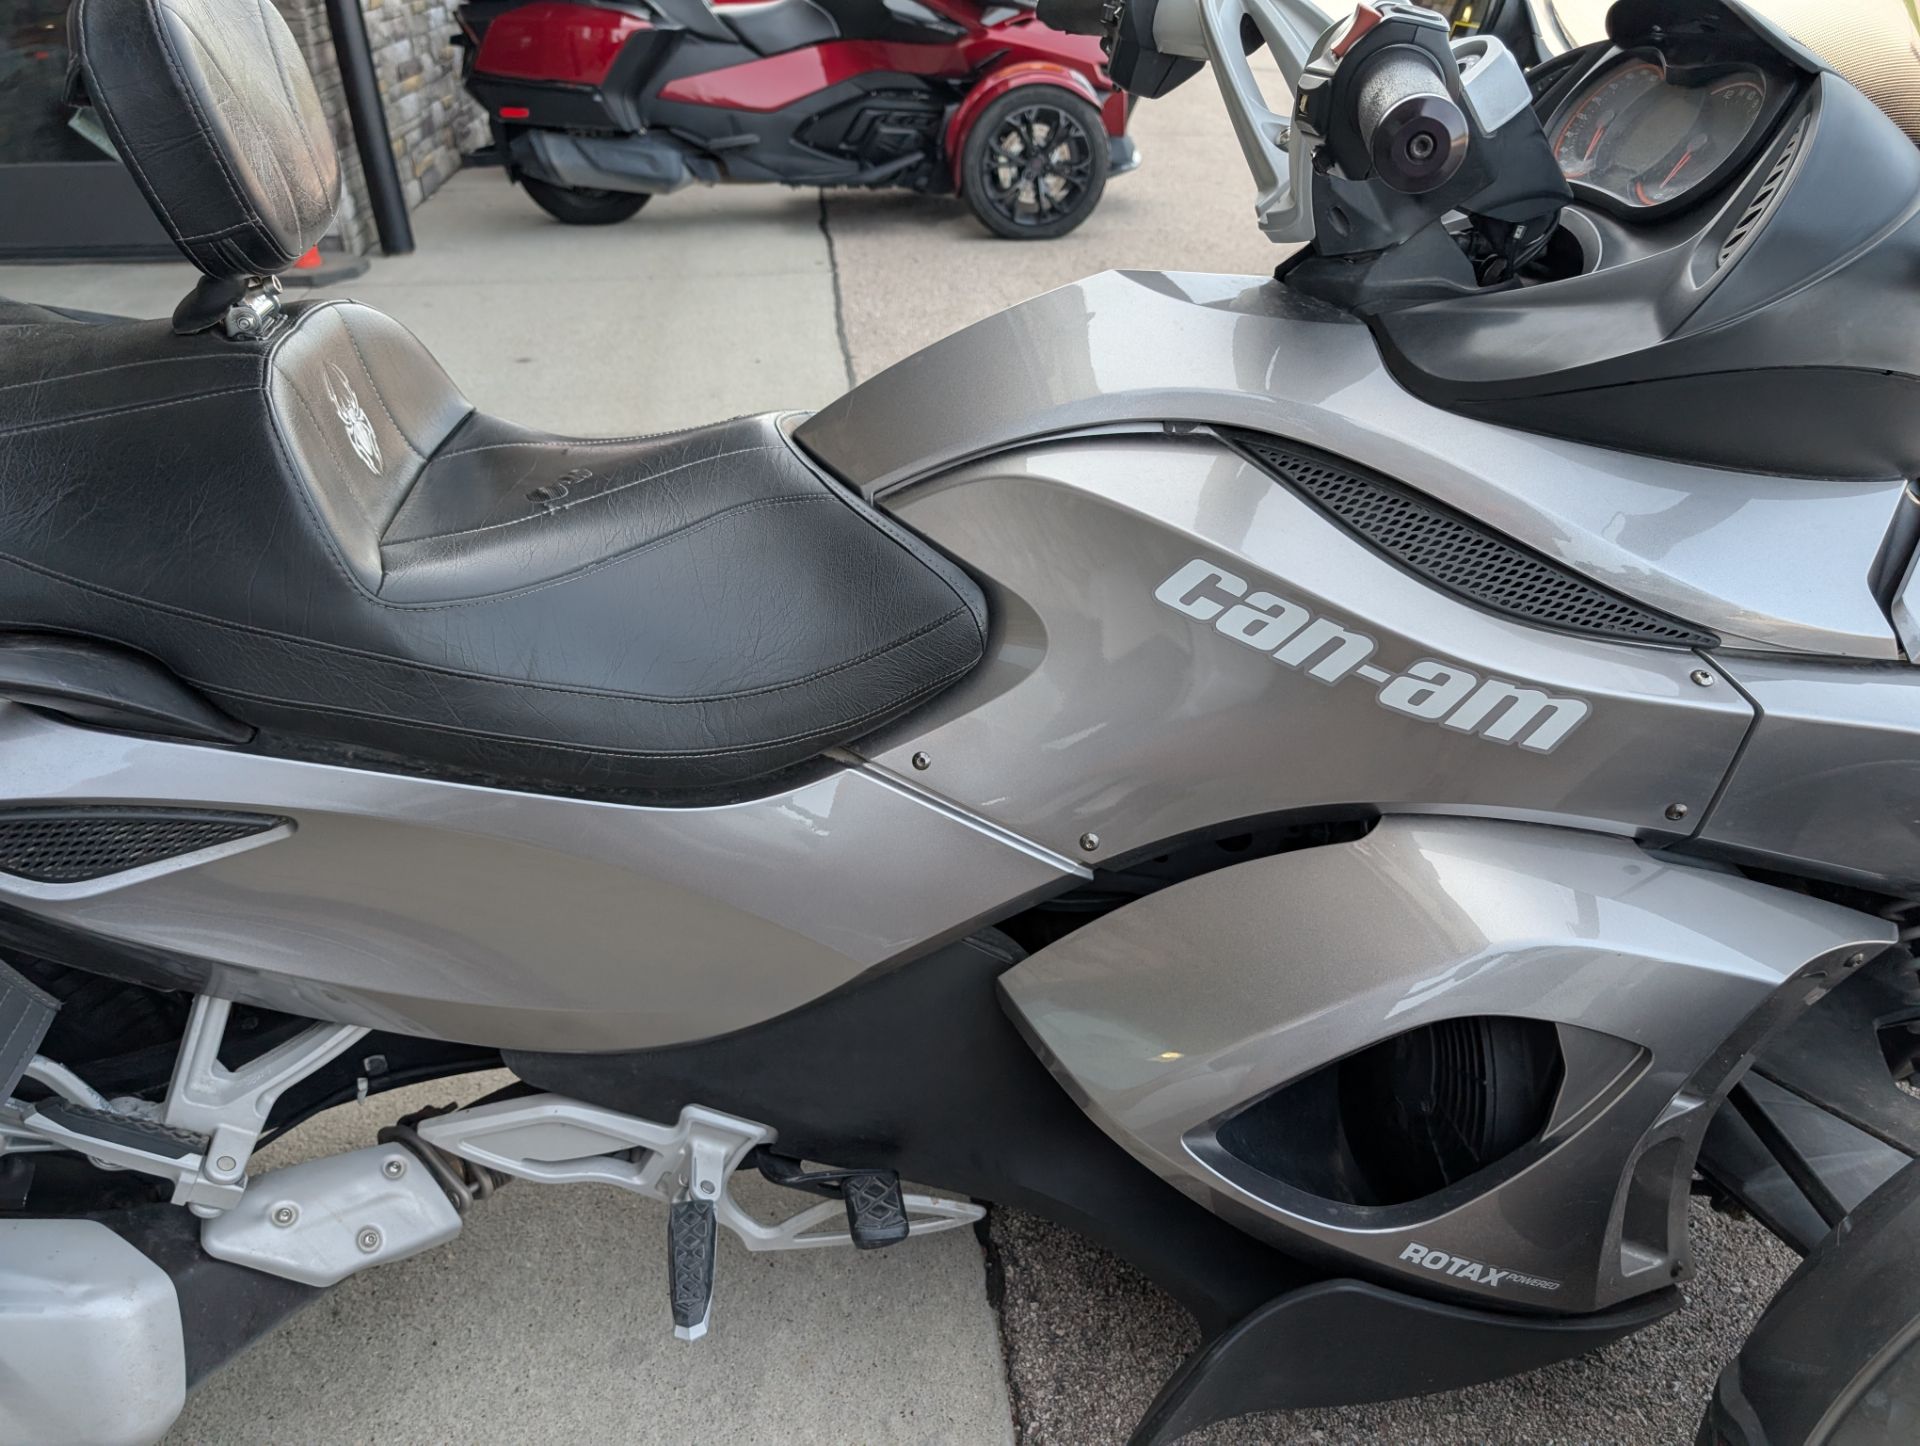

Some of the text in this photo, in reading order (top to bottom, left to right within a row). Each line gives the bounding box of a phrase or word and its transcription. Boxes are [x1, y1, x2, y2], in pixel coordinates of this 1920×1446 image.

[1153, 557, 1590, 753] can-am
[1398, 1242, 1562, 1291] ROTAX POWERED
